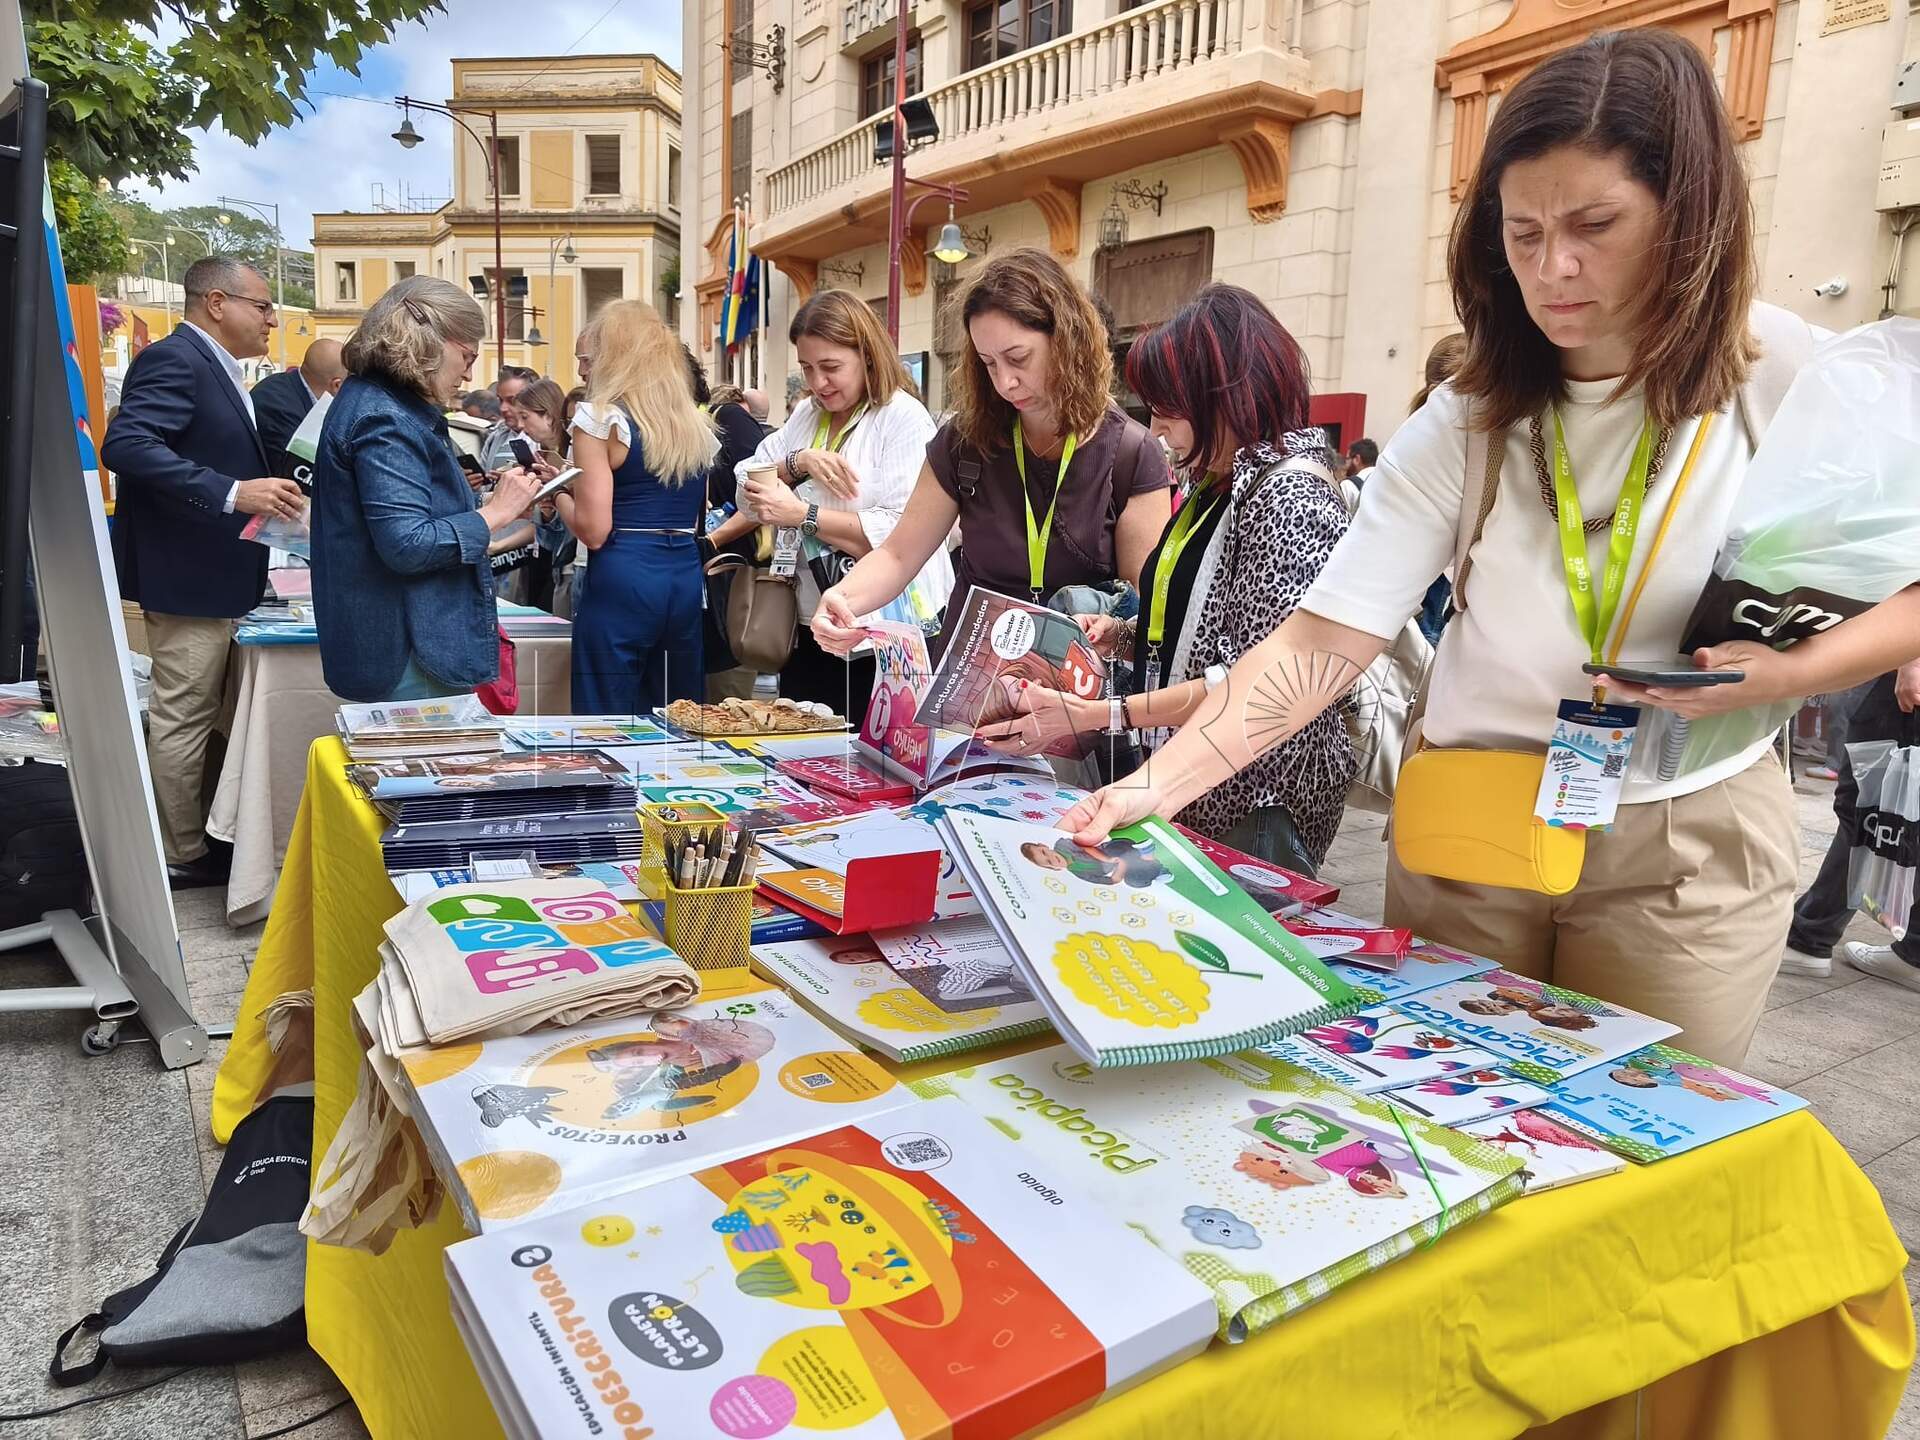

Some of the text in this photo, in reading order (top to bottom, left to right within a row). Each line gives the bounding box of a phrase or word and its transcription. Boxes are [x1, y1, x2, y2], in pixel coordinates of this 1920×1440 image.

[930, 599, 990, 715] Lecturas recomendadas
[893, 729, 923, 766] Henko
[801, 759, 879, 789] Henko
[971, 830, 1027, 921] Consonantes
[1088, 938, 1112, 962] de
[771, 951, 830, 995] Consonantes
[1074, 950, 1132, 1013] Nuevo
[1112, 936, 1190, 1015] las letras
[1296, 964, 1331, 992] algaida
[1400, 1000, 1580, 1069] Picapica
[547, 1126, 688, 1146] PROYECTOS
[988, 1072, 1159, 1175] Picapica
[1607, 1104, 1683, 1147] Mrs.
[251, 1155, 308, 1168] EDUCA EDTECH
[1016, 1171, 1065, 1207] algaida
[624, 1303, 685, 1367] PLANETA
